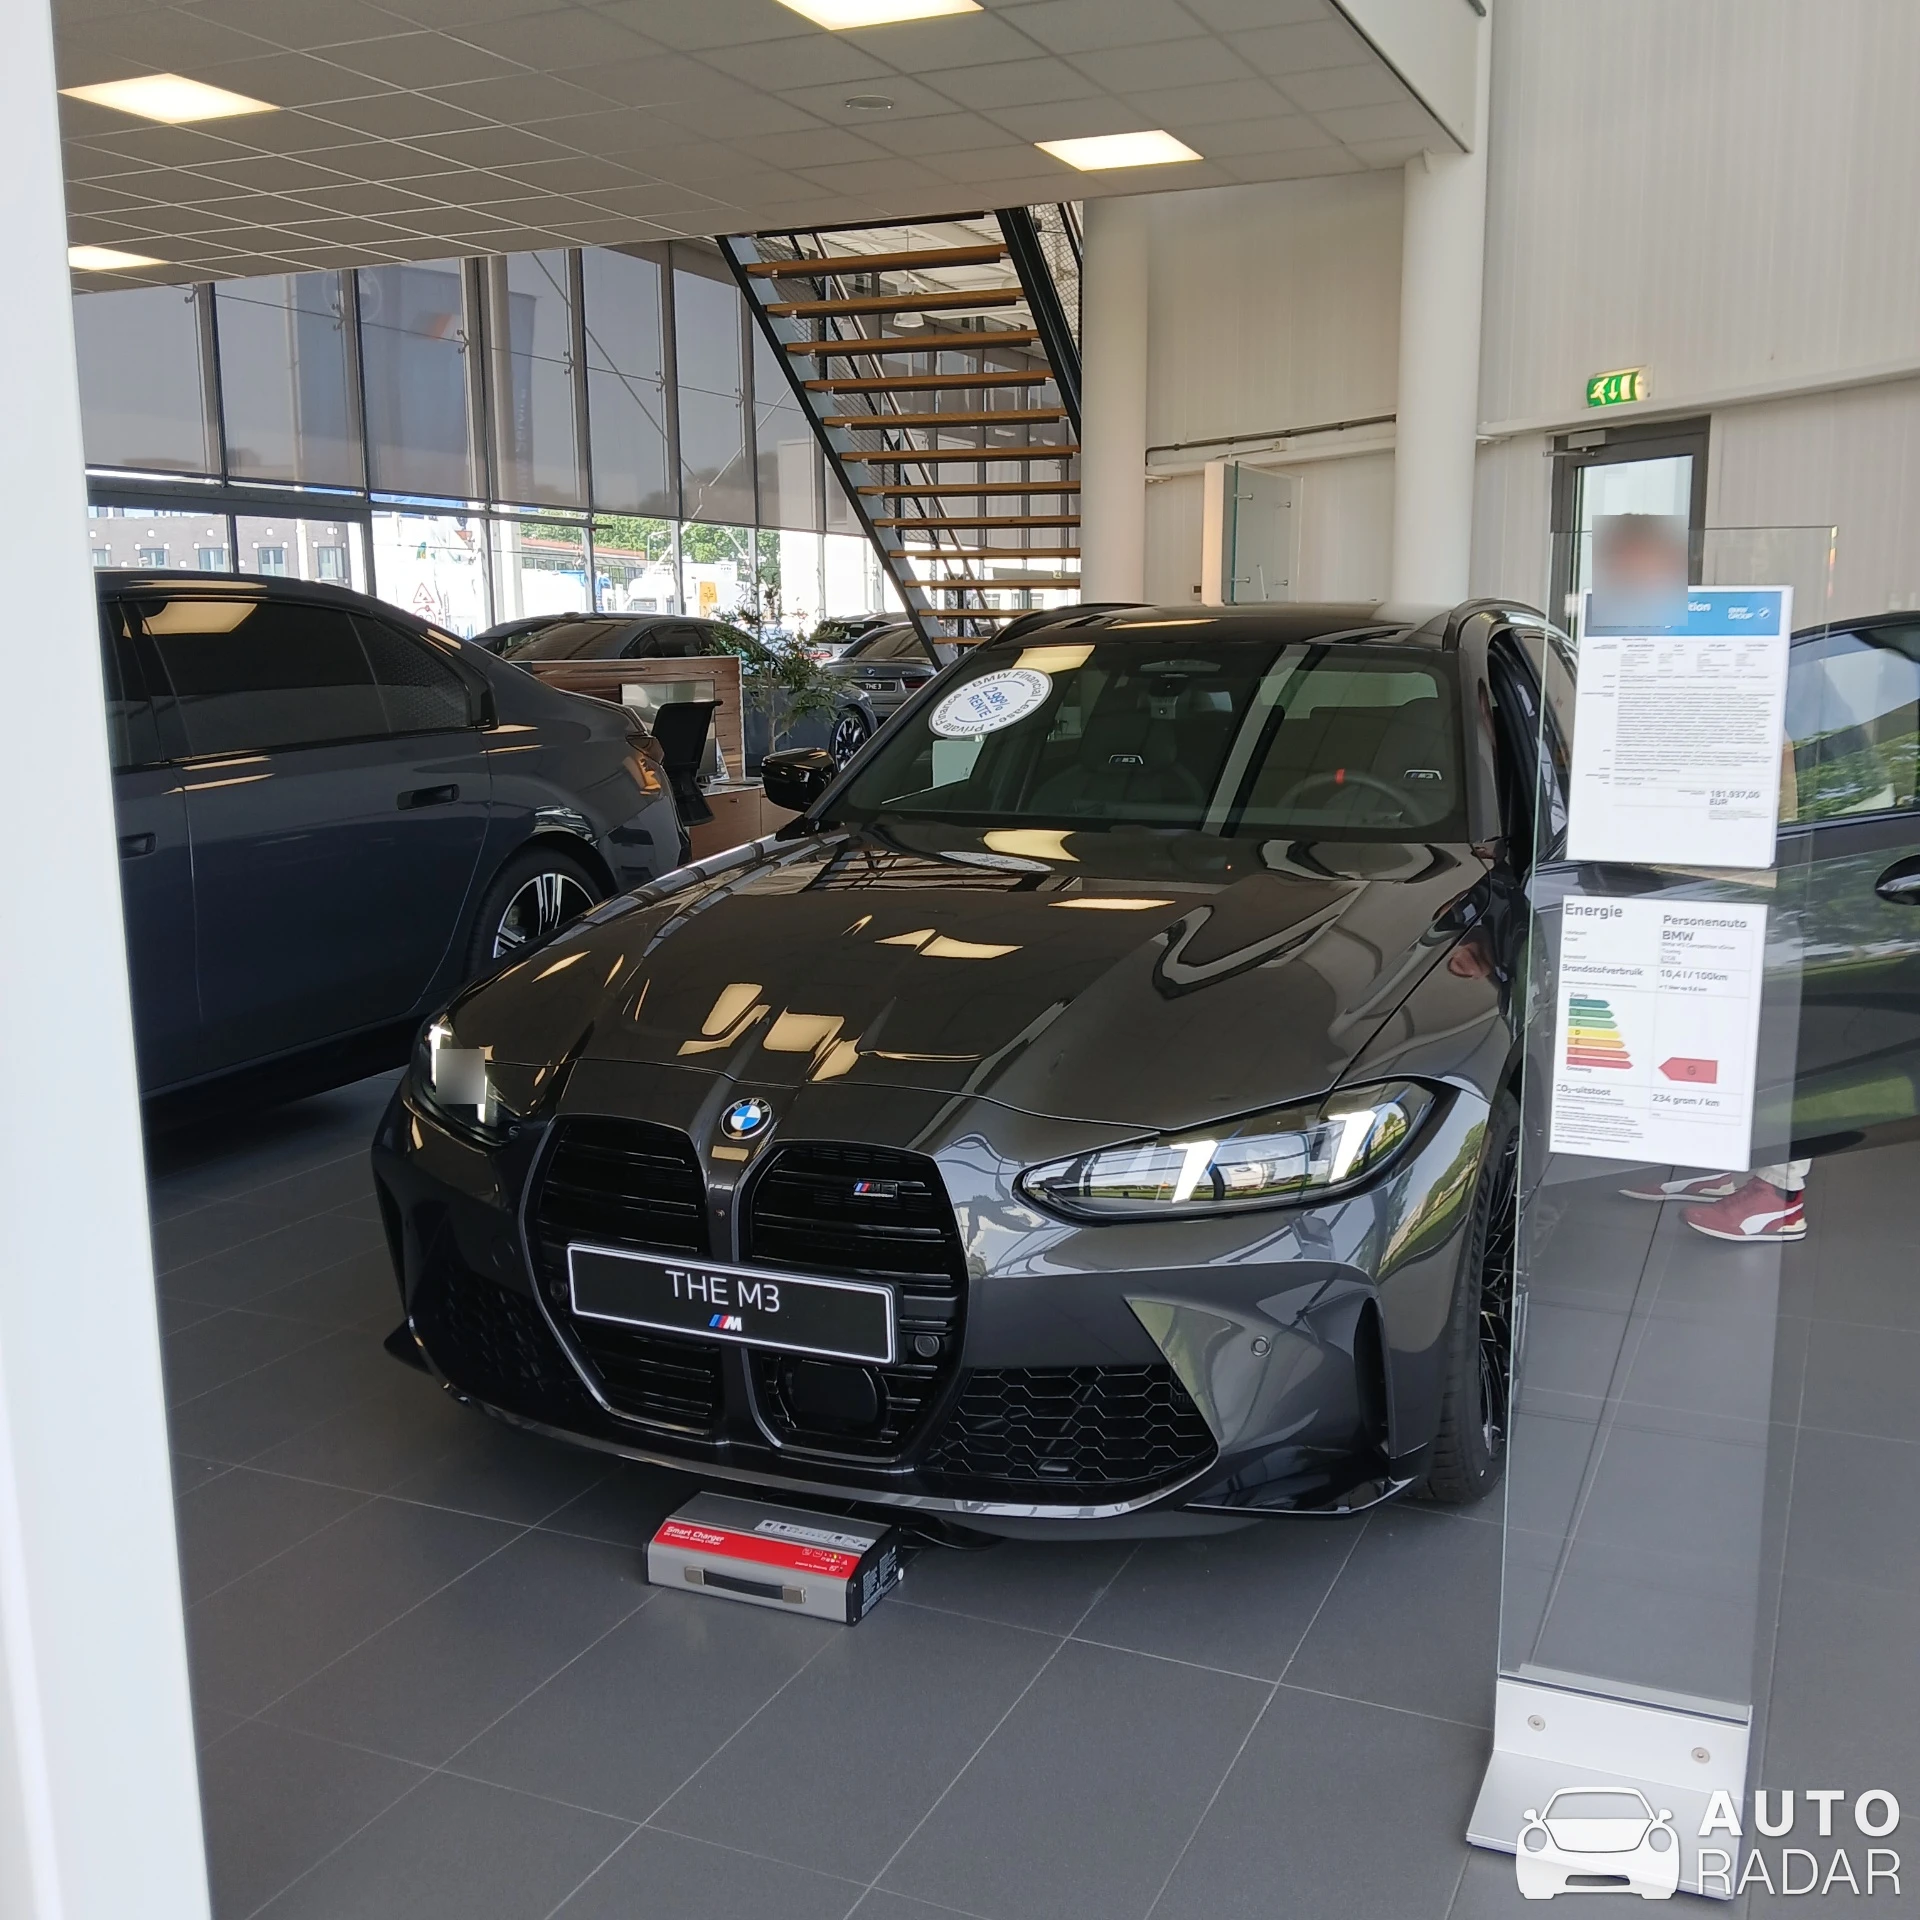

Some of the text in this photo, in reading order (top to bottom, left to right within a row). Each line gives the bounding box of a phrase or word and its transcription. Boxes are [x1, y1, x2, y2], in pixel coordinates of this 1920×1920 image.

[972, 671, 1045, 723] BMW Financial Lease
[935, 693, 985, 734] Private Finance
[967, 694, 992, 718] RENTE
[1709, 798, 1728, 806] EUR
[1565, 903, 1623, 920] Energie
[1663, 914, 1748, 928] Personenauto
[1662, 930, 1695, 941] BMW
[1562, 964, 1644, 976] Brandstofverbruik
[1652, 1094, 1671, 1102] 234
[1673, 1097, 1698, 1105] gram
[1705, 1098, 1720, 1107] km
[665, 1270, 780, 1313] THE M3
[666, 1526, 692, 1536] Smart
[693, 1531, 725, 1543] Charger
